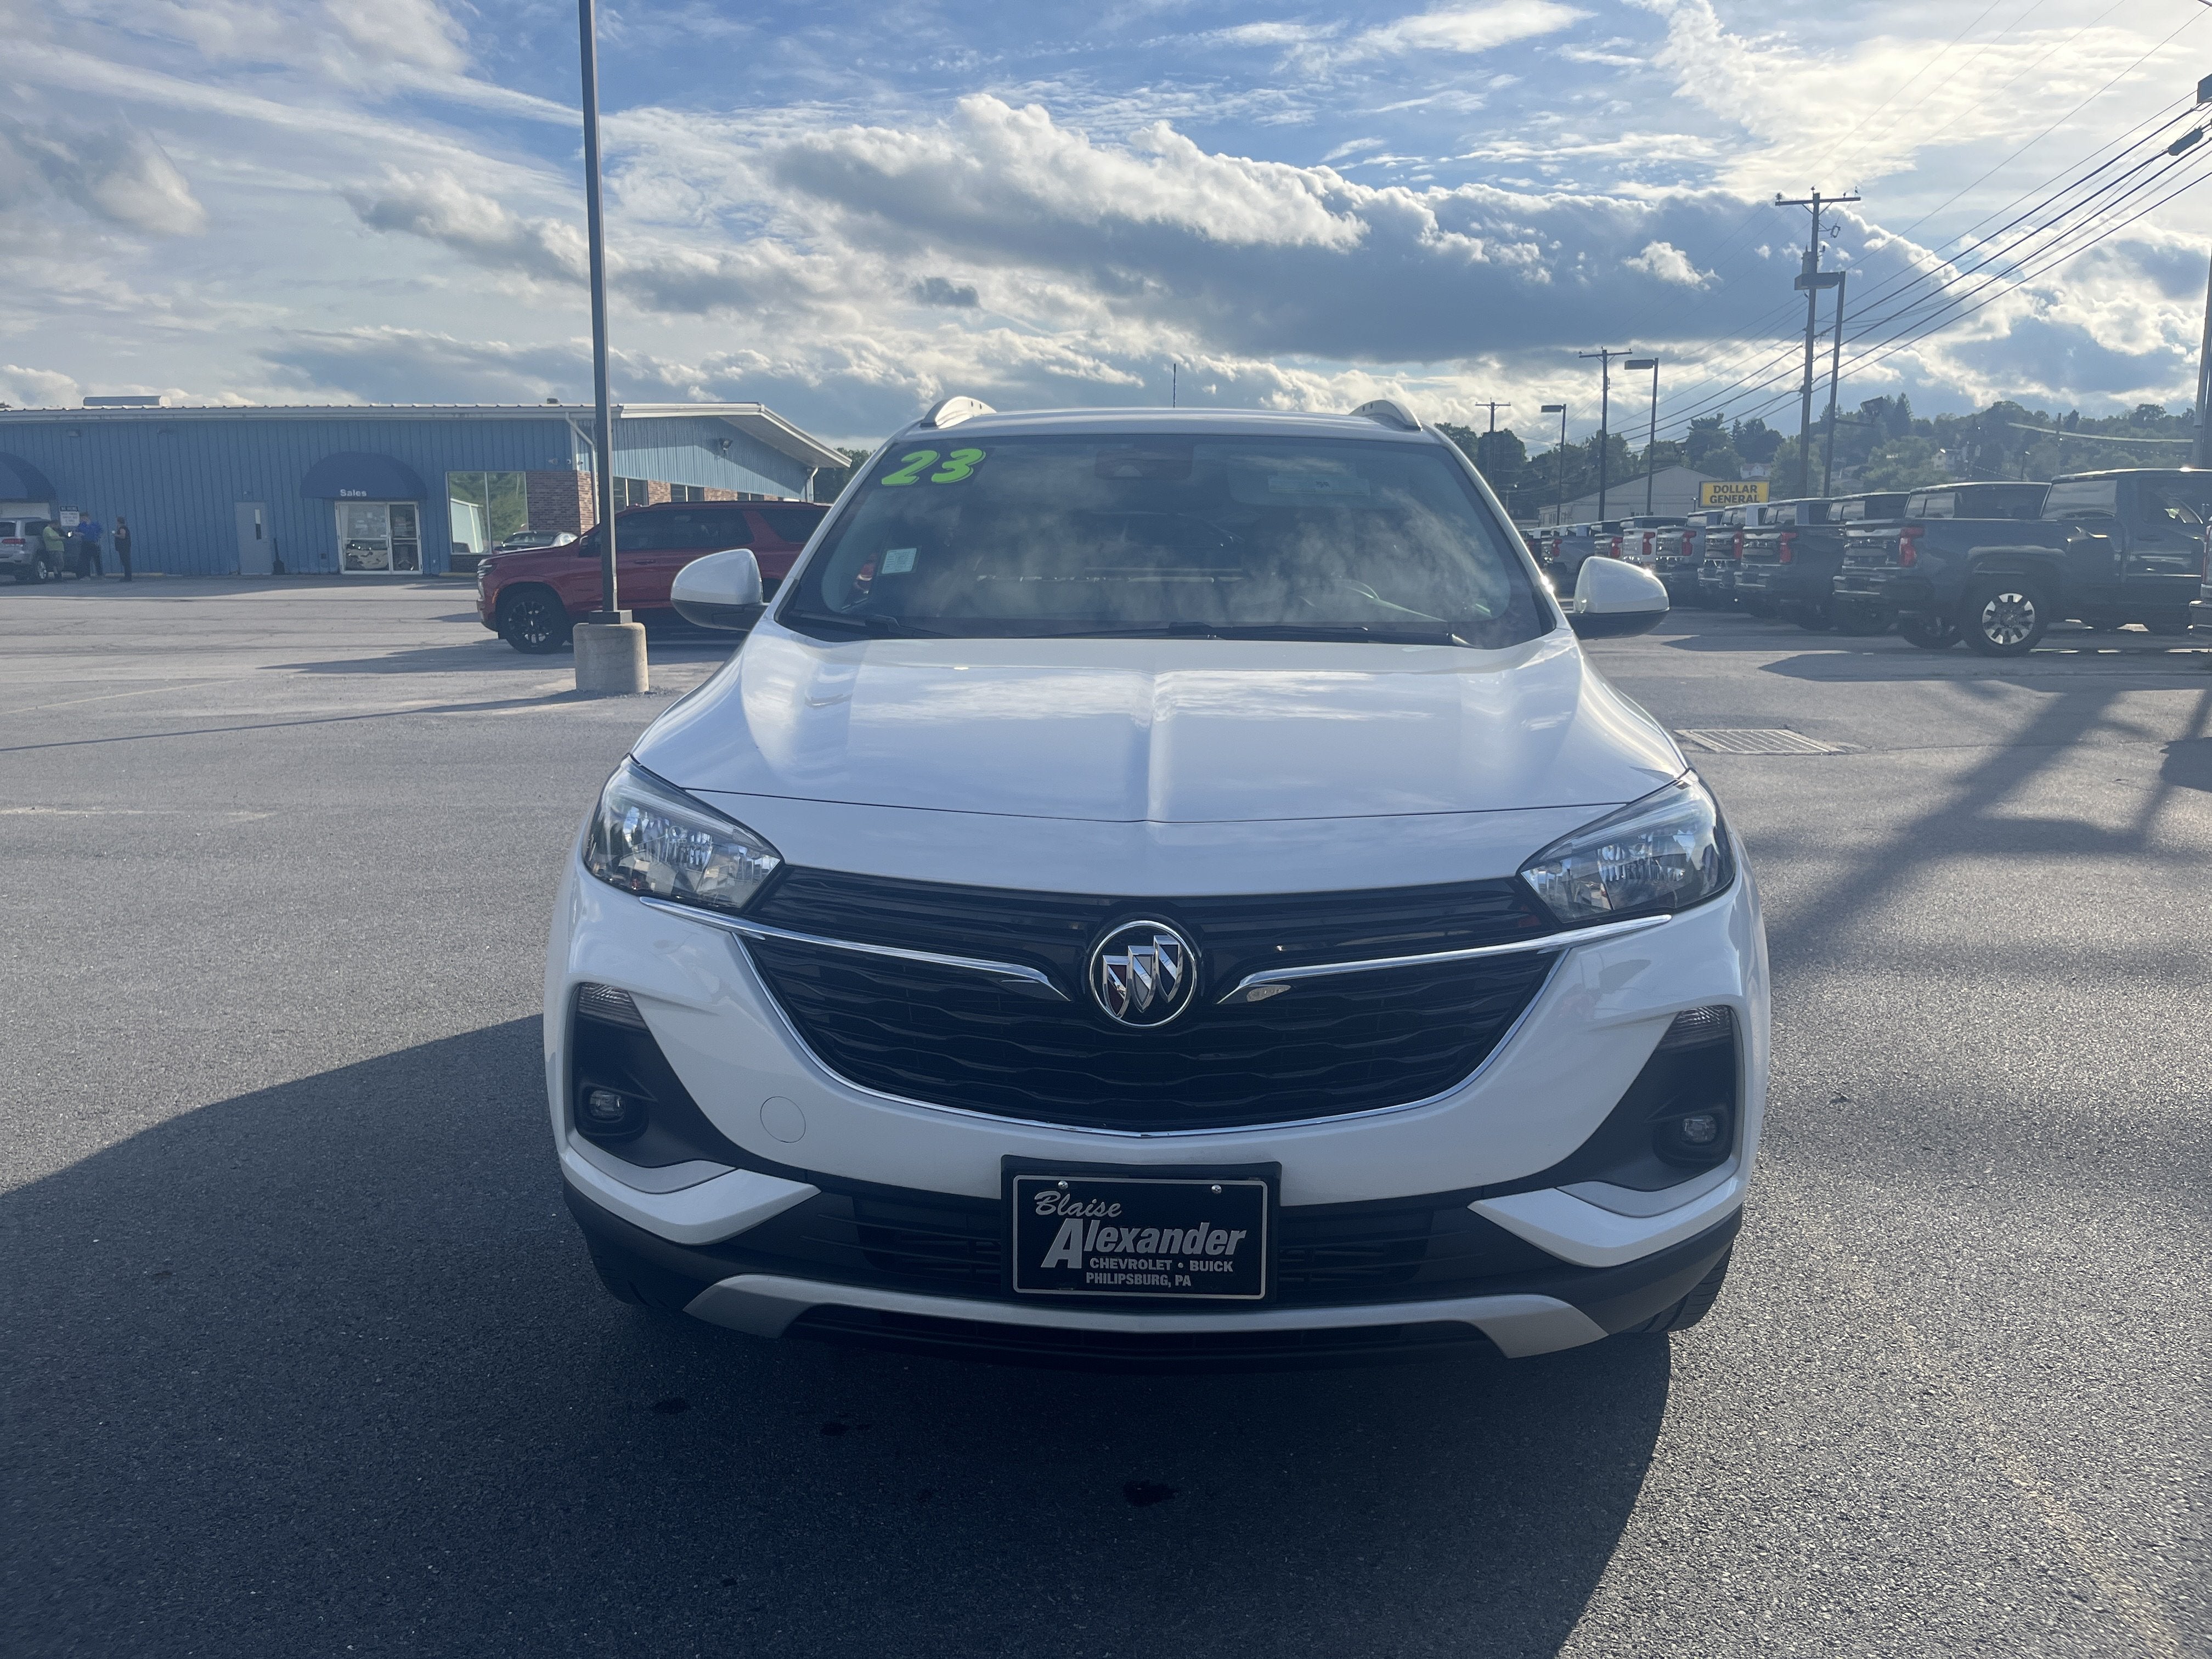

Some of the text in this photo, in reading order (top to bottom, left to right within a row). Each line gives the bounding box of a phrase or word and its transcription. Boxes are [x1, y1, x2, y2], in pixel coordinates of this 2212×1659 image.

[881, 448, 986, 486] 23
[1713, 485, 1758, 494] DOLLAR
[1709, 494, 1760, 504] GENERAL
[1034, 1190, 1122, 1217] Blaise
[1040, 1217, 1247, 1269] Alexander
[1090, 1257, 1233, 1272] CHEVROLET BUICK
[1086, 1271, 1192, 1288] PHILIPSBURG, PA
